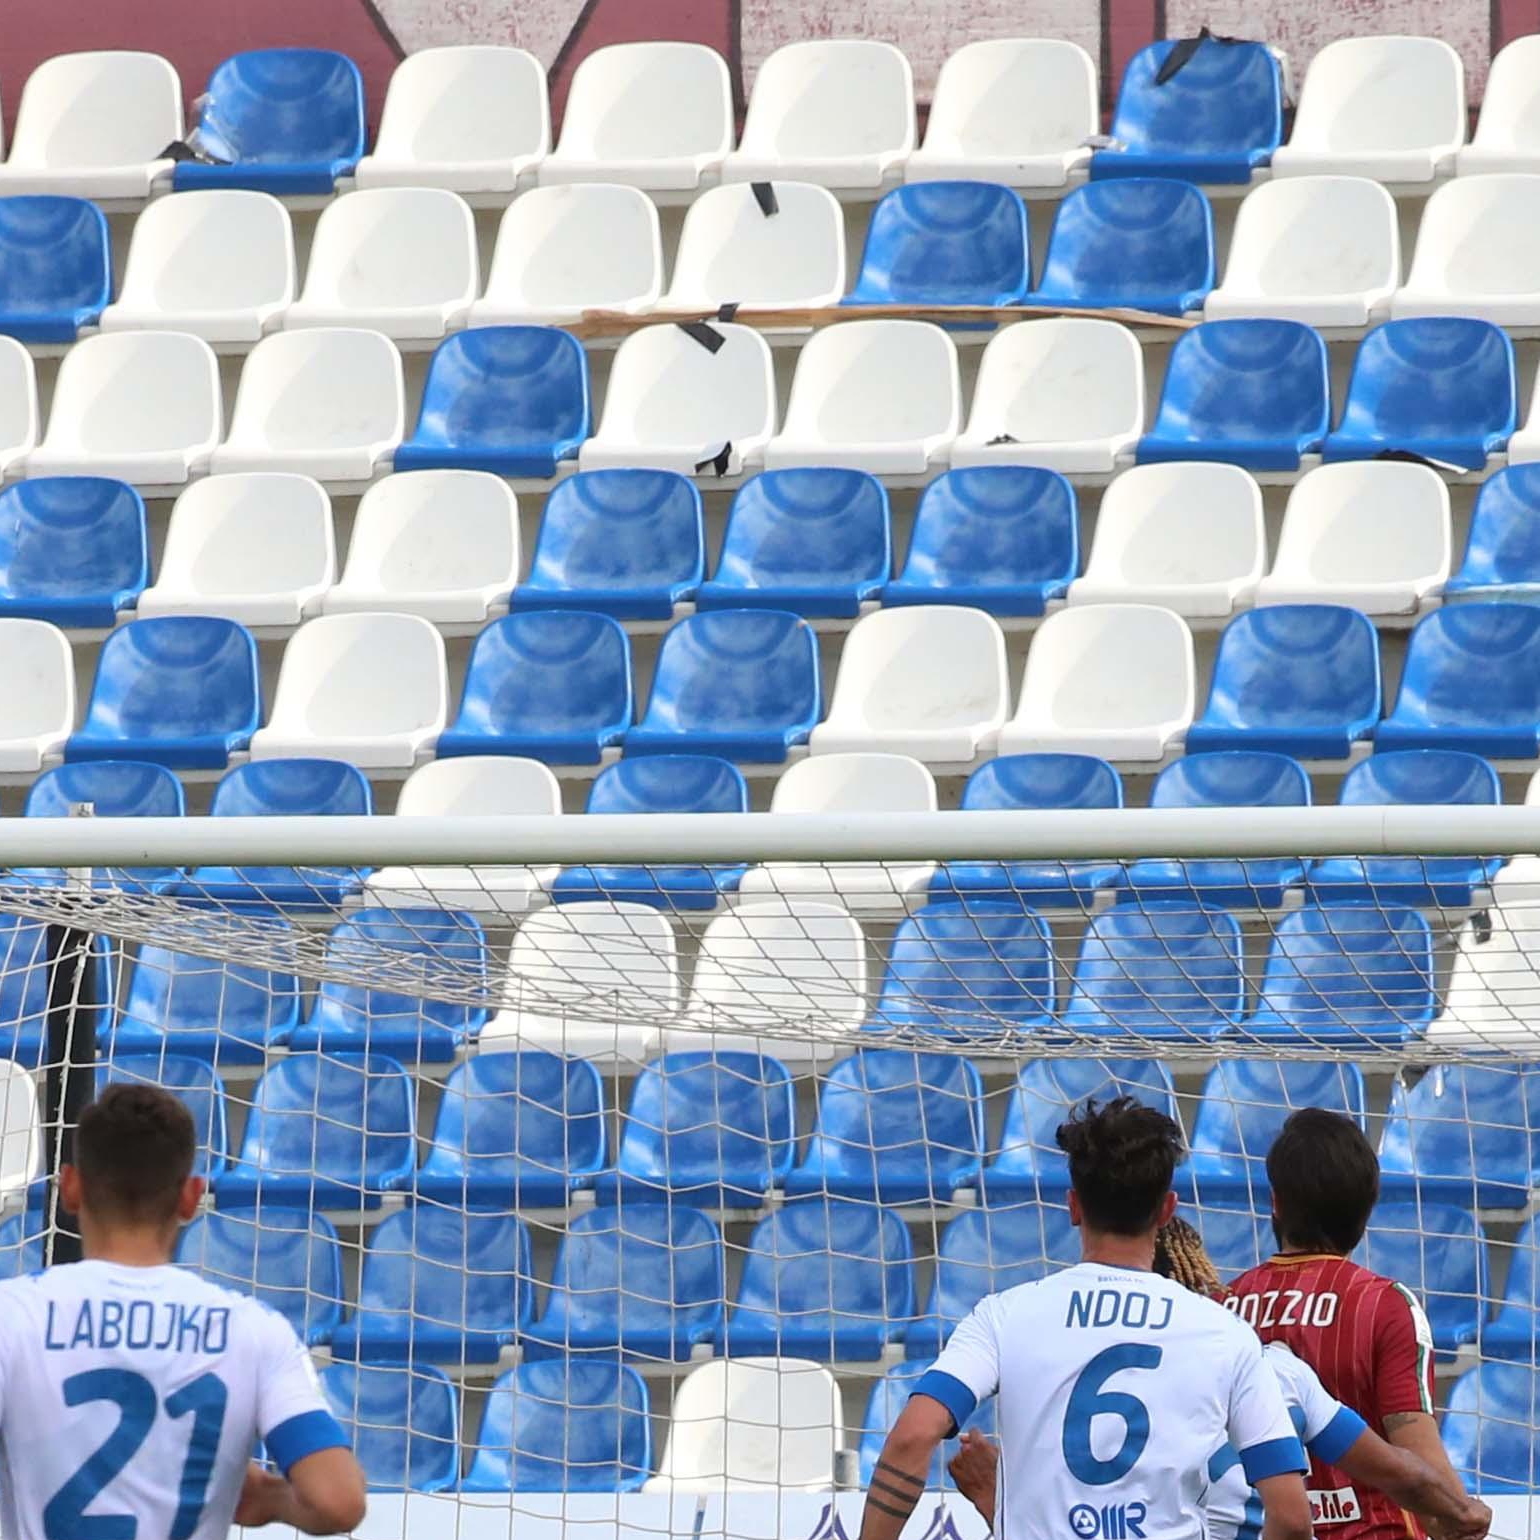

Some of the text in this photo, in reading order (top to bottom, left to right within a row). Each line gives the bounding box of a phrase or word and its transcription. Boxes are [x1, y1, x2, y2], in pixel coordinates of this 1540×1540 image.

[44, 1299, 231, 1355] LABOJKO
[1065, 1289, 1172, 1330] NDOJ
[1062, 1342, 1164, 1486] 6
